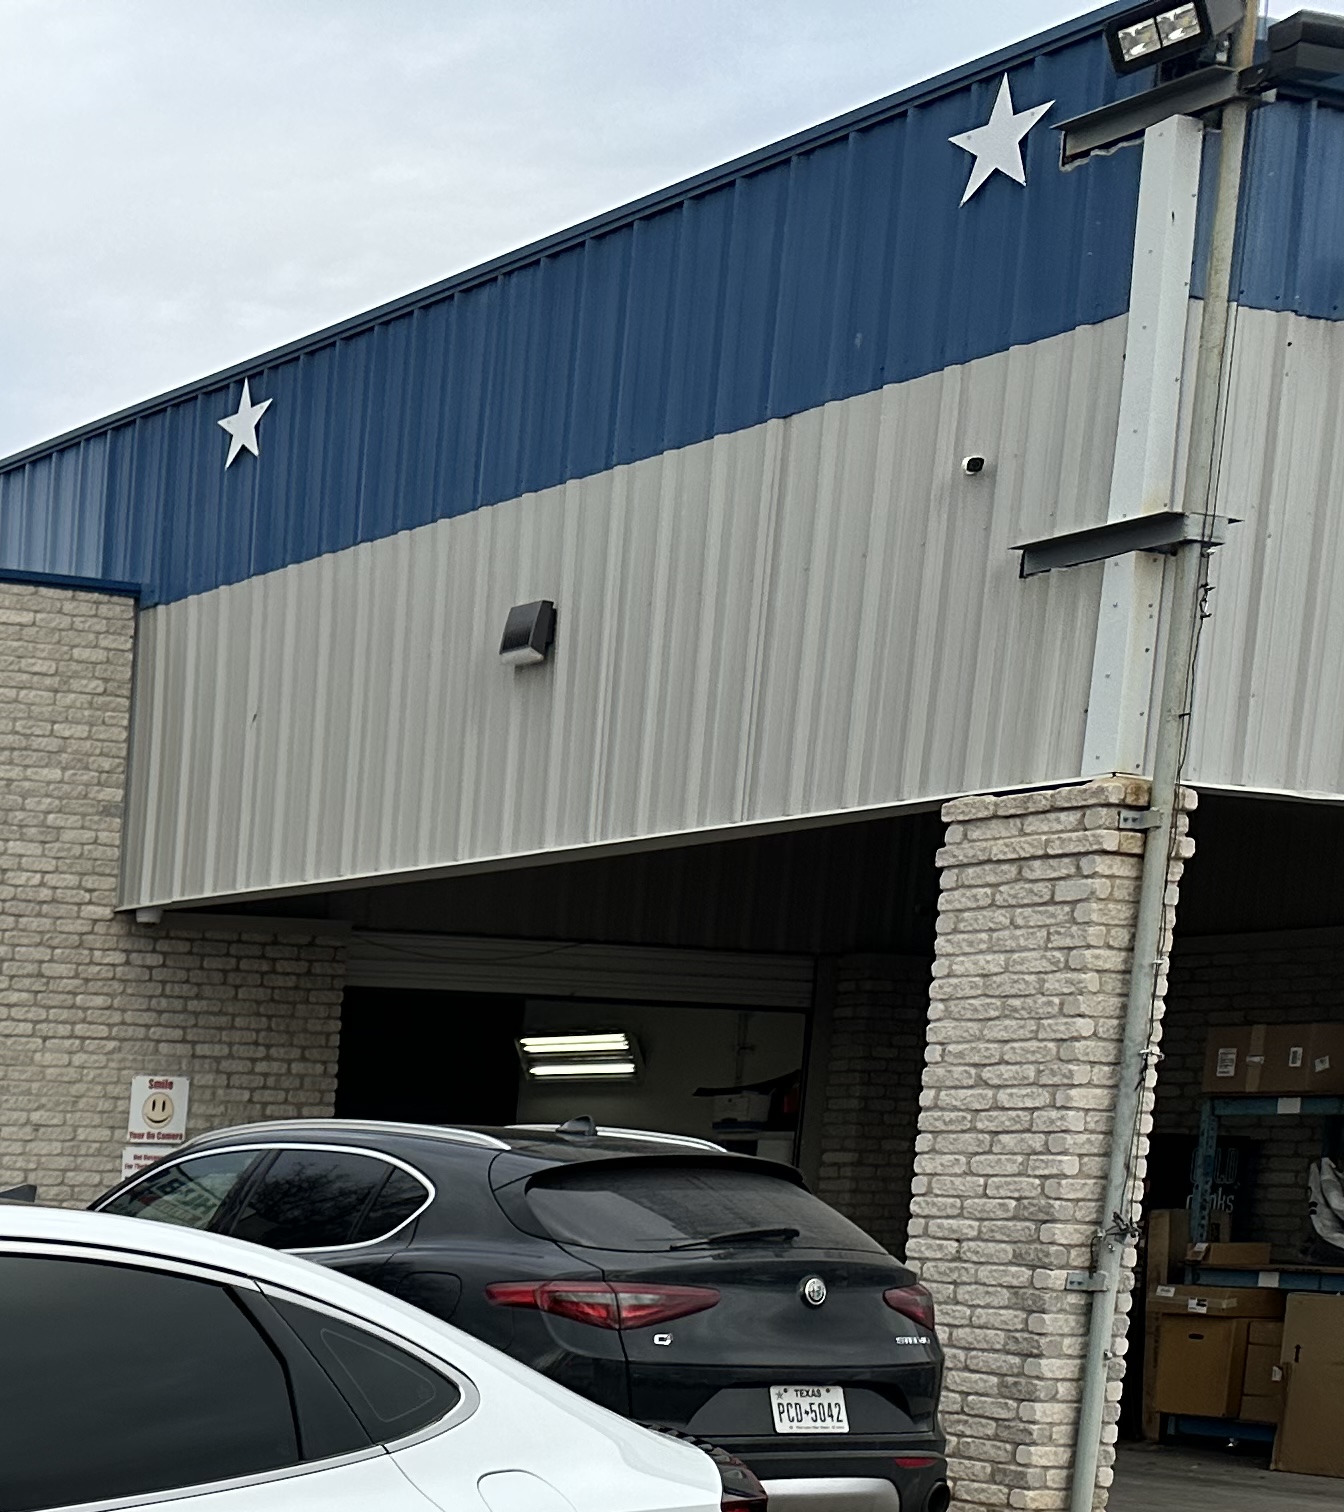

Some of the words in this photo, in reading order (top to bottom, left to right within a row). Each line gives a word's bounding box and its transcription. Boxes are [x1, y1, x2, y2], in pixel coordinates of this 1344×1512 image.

[148, 1079, 174, 1090] Smile
[156, 1131, 183, 1141] Camera
[794, 1388, 822, 1398] TEXAS
